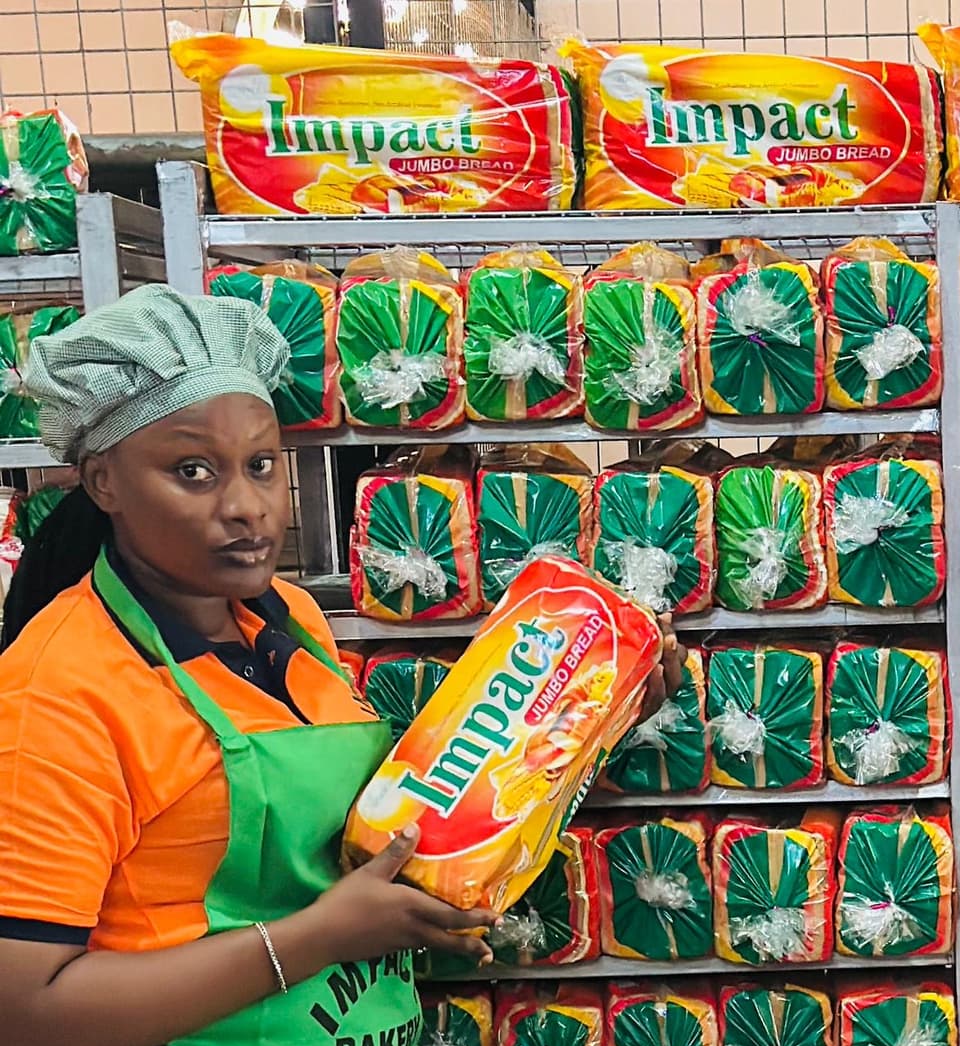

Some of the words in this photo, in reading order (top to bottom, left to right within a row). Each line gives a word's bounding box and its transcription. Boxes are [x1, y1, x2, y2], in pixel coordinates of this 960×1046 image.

[265, 99, 482, 165] Impact
[645, 86, 858, 156] Impact
[775, 147, 832, 163] JUMBO
[836, 146, 892, 161] BREAD
[397, 157, 454, 173] JUMBO
[458, 157, 515, 171] BREAD
[533, 665, 568, 720] JUMBO
[566, 615, 602, 670] BREAD
[398, 618, 568, 815] Impact
